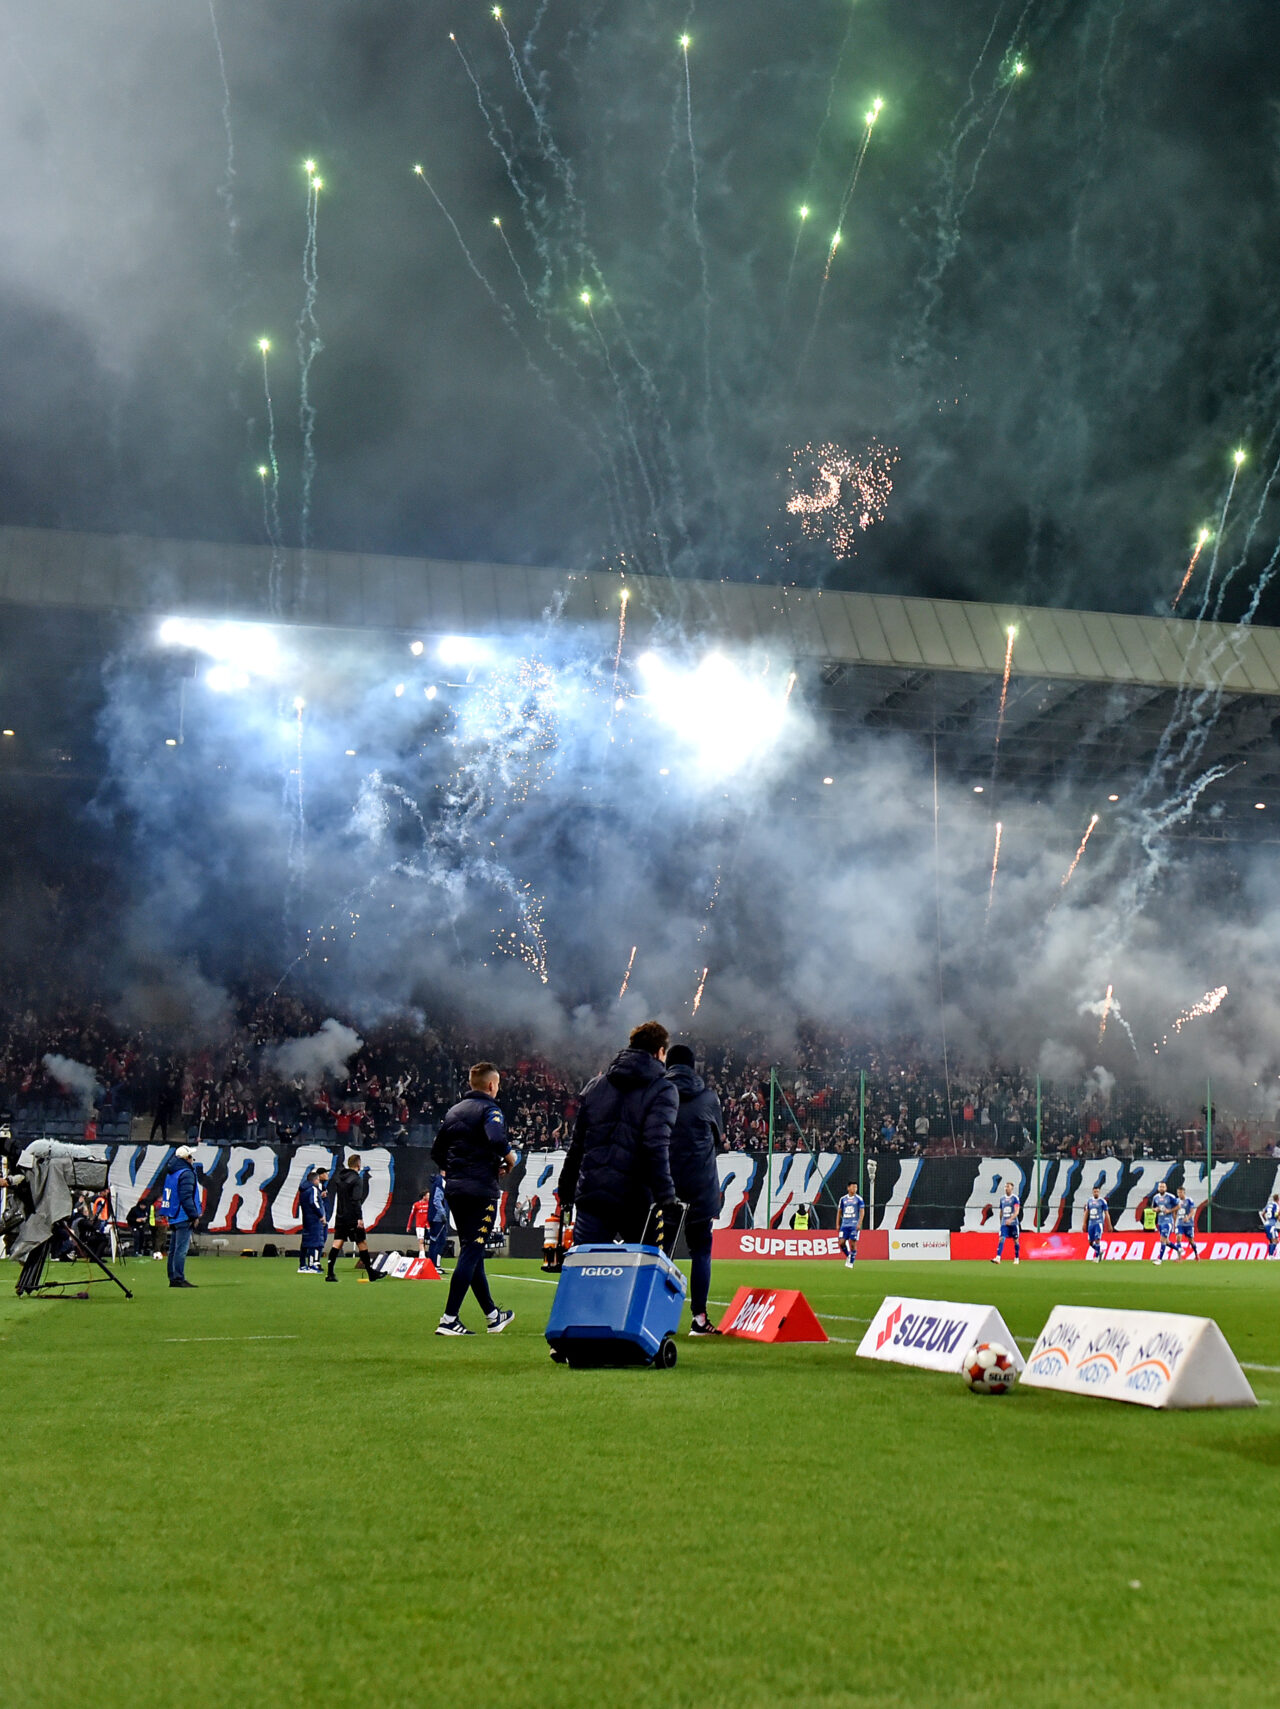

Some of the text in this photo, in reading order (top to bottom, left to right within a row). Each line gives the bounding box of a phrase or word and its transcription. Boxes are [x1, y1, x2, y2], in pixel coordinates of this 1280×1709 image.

[740, 1234, 850, 1256] SUPERBE
[580, 1267, 624, 1278] IGLOO
[730, 1293, 776, 1334] Betclic
[893, 1313, 968, 1354] SUZUKI
[1032, 1356, 1062, 1377] MOSTY
[1077, 1362, 1111, 1384] MOSTY
[1127, 1369, 1162, 1393] MOSTY
